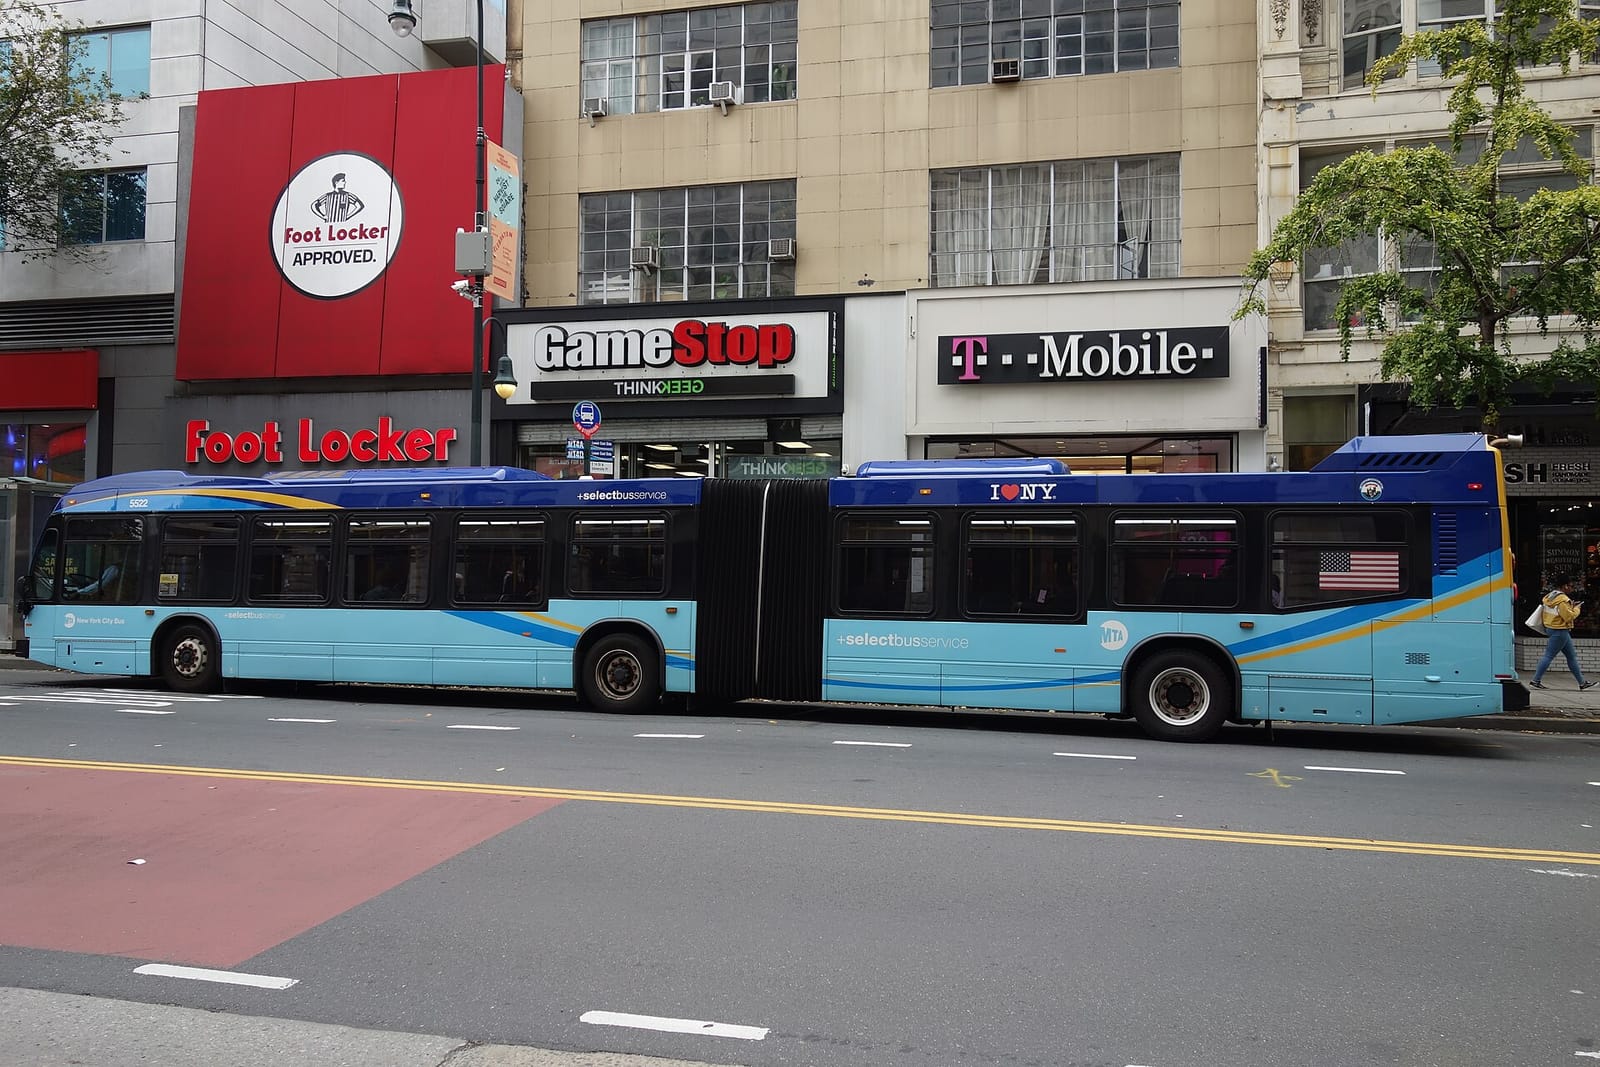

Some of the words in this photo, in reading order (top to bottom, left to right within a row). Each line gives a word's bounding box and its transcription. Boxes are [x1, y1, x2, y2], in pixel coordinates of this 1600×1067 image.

[285, 227, 321, 244] Foot
[328, 223, 388, 241] Locker
[292, 249, 377, 267] APPROVED.
[533, 319, 796, 371] GameStop
[185, 419, 285, 463] Foot
[298, 415, 456, 463] Locker
[1504, 463, 1547, 483] SH
[1552, 462, 1591, 471] FRESH
[129, 499, 149, 508] 5522
[77, 616, 89, 625] New
[101, 616, 113, 625] City
[1100, 625, 1125, 644] MTA
